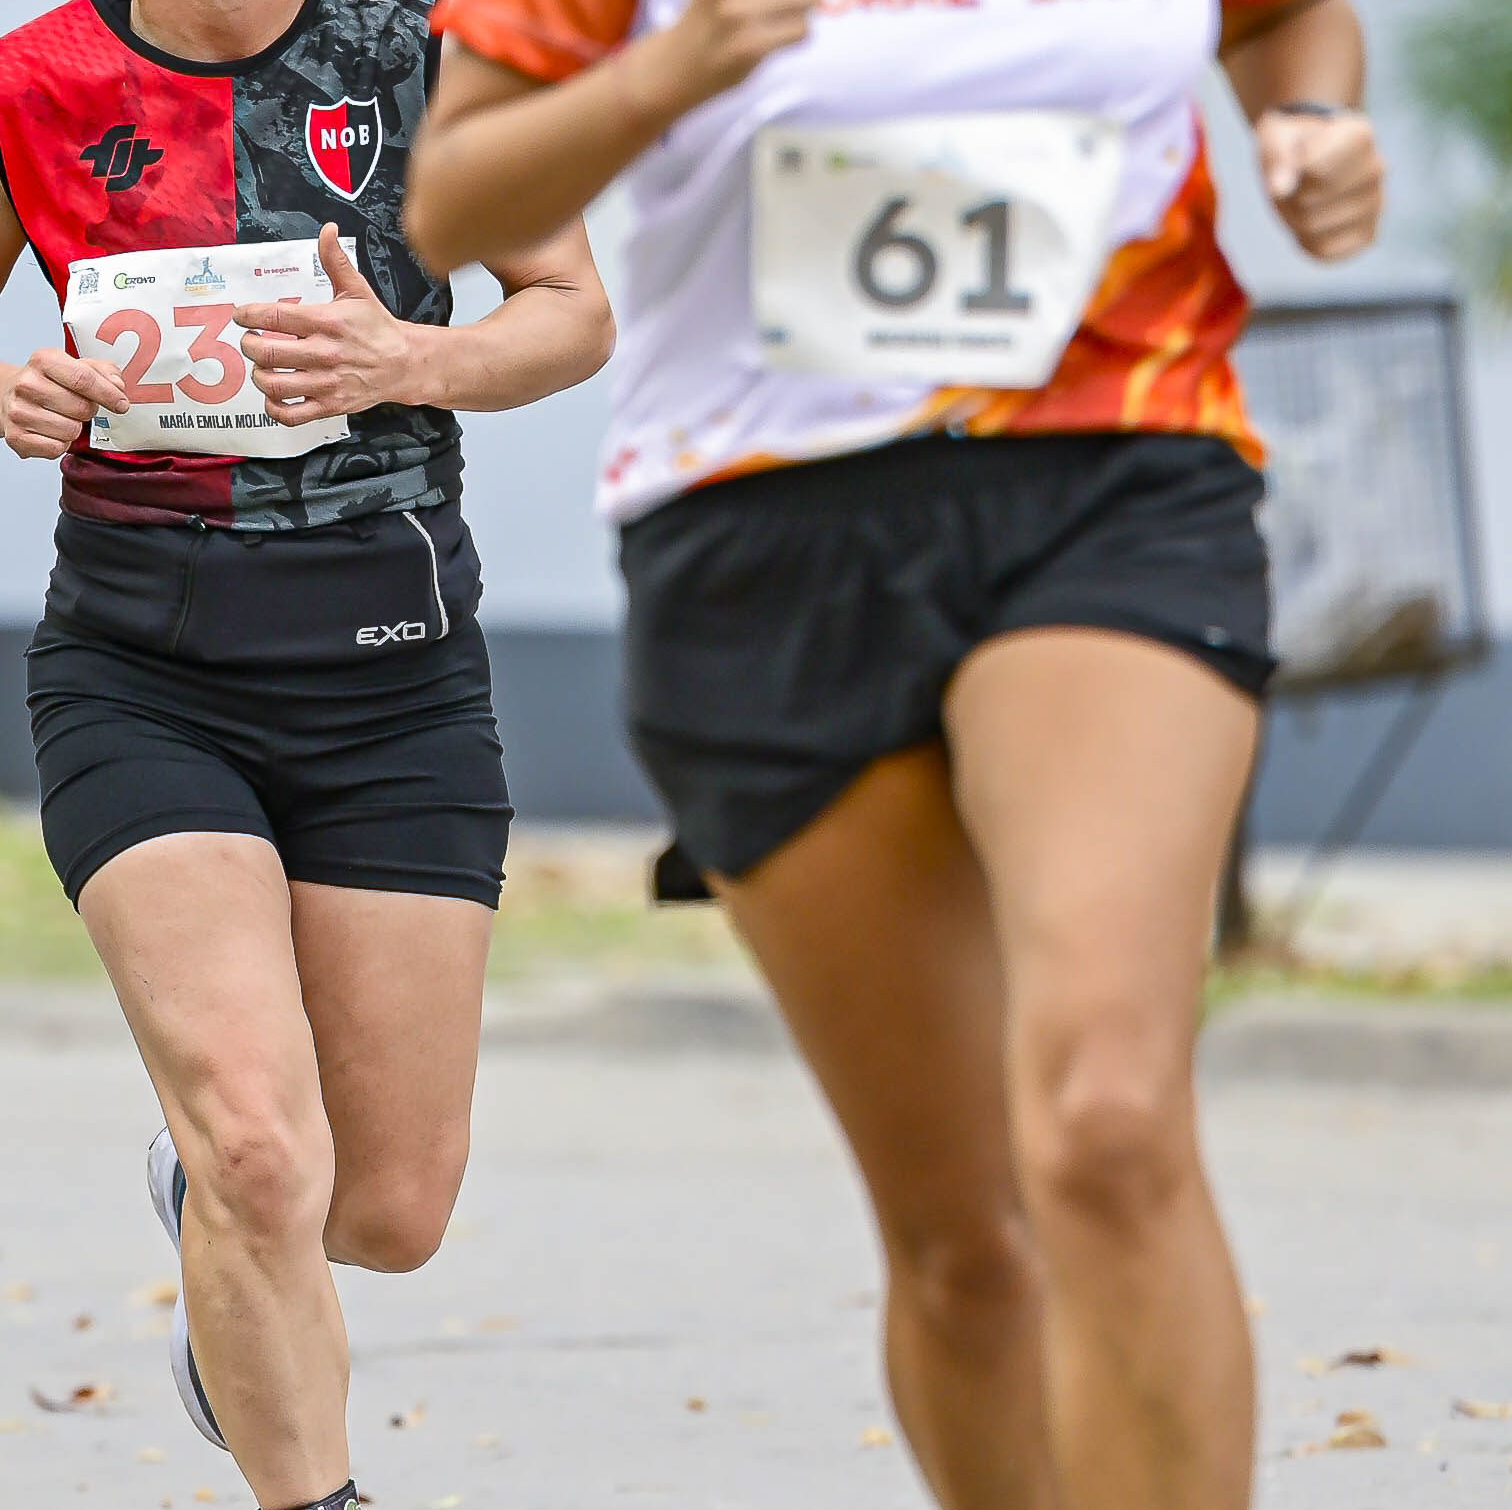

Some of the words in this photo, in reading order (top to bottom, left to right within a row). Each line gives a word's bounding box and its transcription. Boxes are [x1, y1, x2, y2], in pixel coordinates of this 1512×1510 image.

[320, 124, 370, 150] NOB
[854, 194, 1031, 311] 61
[95, 297, 301, 405] 23
[158, 412, 194, 429] MARÍA
[196, 414, 233, 429] EMILIA
[355, 620, 426, 647] EXO
